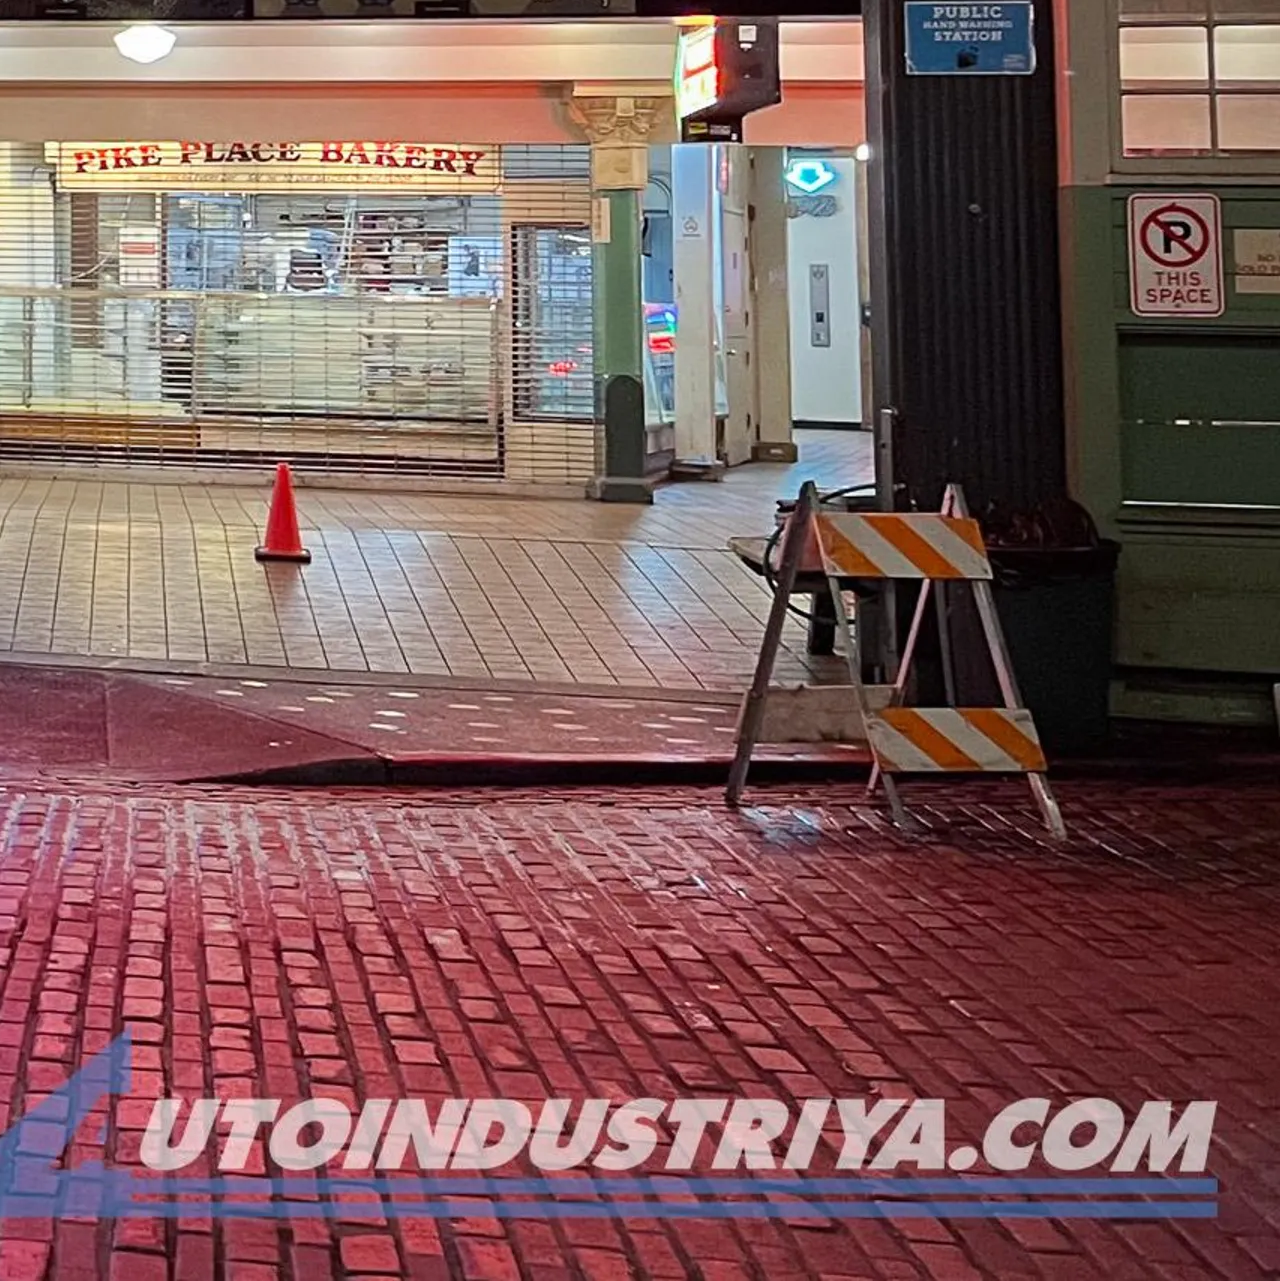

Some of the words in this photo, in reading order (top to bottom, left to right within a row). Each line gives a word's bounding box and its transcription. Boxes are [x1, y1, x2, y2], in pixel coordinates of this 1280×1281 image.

[933, 6, 1002, 18] PUBLIC
[923, 21, 956, 29] HAND
[934, 31, 1002, 41] STATION
[74, 144, 162, 173] PIKE
[180, 140, 302, 163] PLACE
[319, 140, 486, 176] BAKERY
[1154, 271, 1201, 286] THIS
[1146, 289, 1212, 304] SPACE
